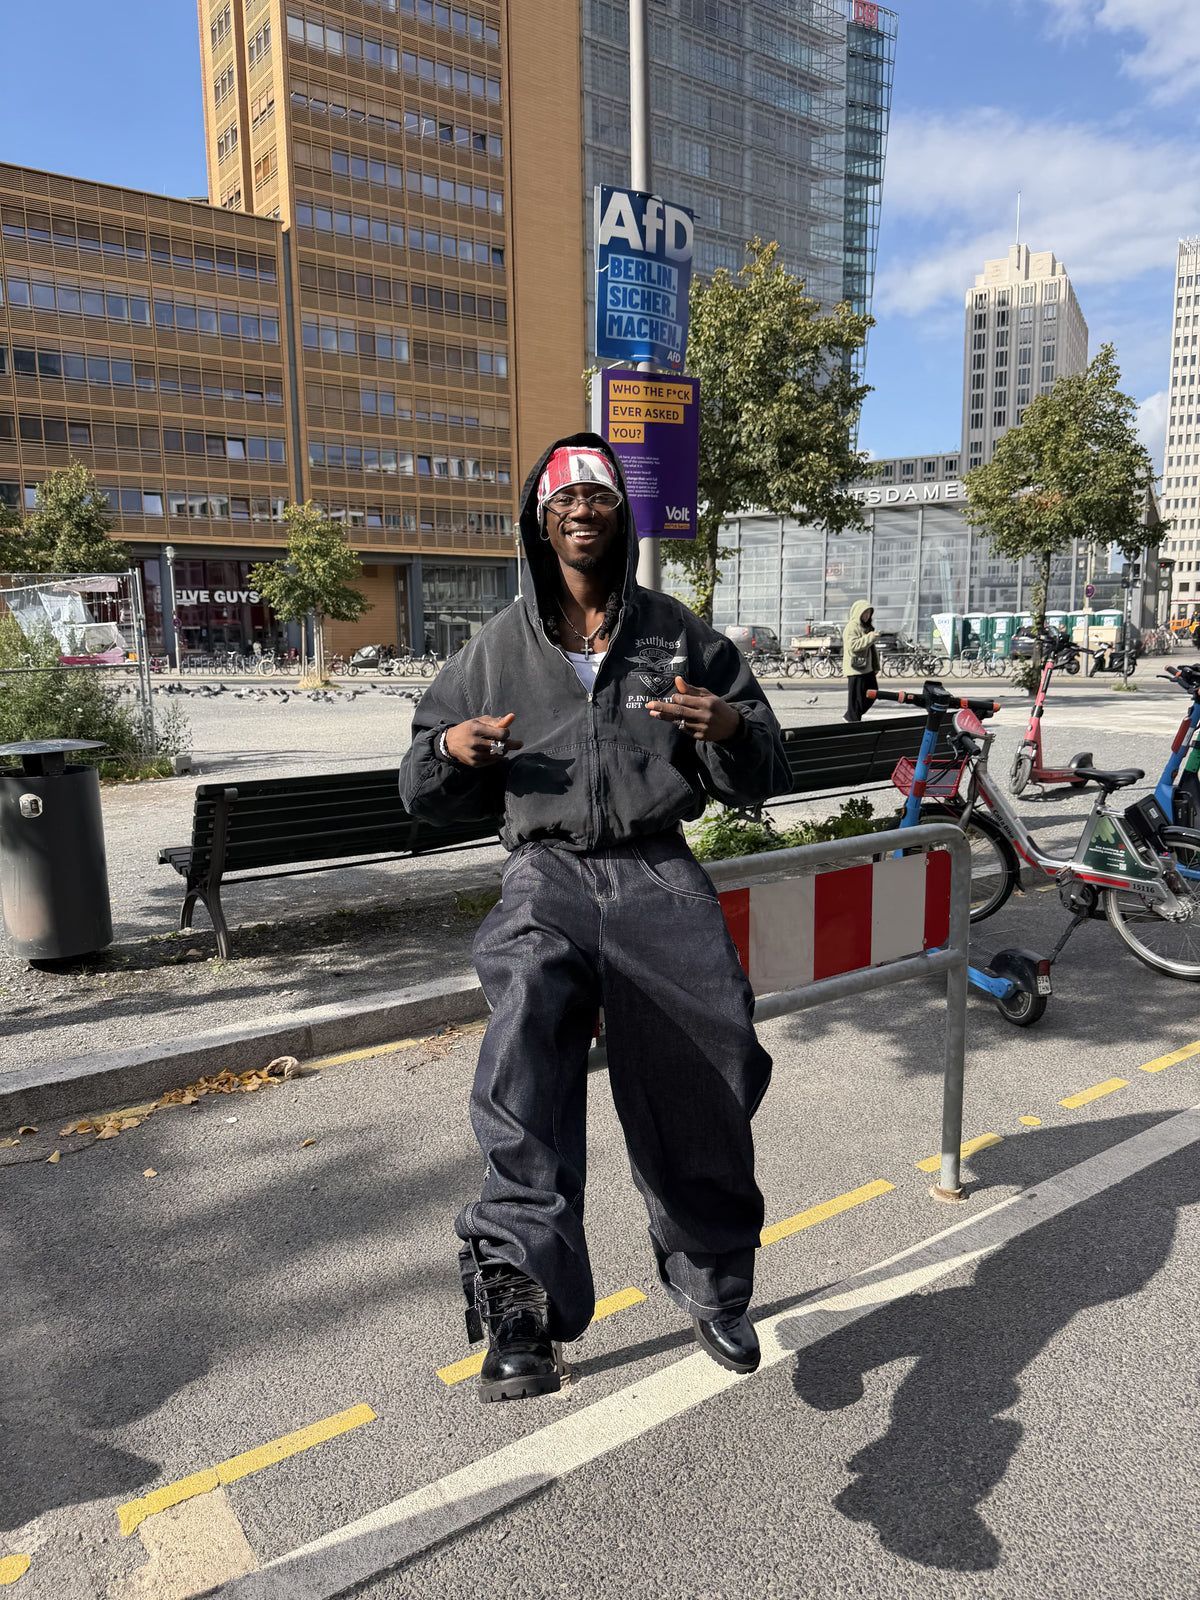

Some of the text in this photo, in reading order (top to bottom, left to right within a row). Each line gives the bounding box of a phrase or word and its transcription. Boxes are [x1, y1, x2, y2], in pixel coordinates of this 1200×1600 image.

[856, 3, 875, 22] DB
[600, 192, 694, 262] AfD
[610, 257, 676, 291] BERLIN.
[609, 285, 675, 318] SICHER.
[608, 314, 680, 348] MACHEN.
[667, 350, 681, 363] AfD
[612, 383, 641, 396] WHO
[643, 386, 664, 398] THE
[612, 406, 679, 421] EVER ASKED
[612, 428, 642, 439] YOU?
[665, 505, 690, 521] Volt
[213, 590, 260, 604] GUYS
[634, 635, 681, 649] Ruthless
